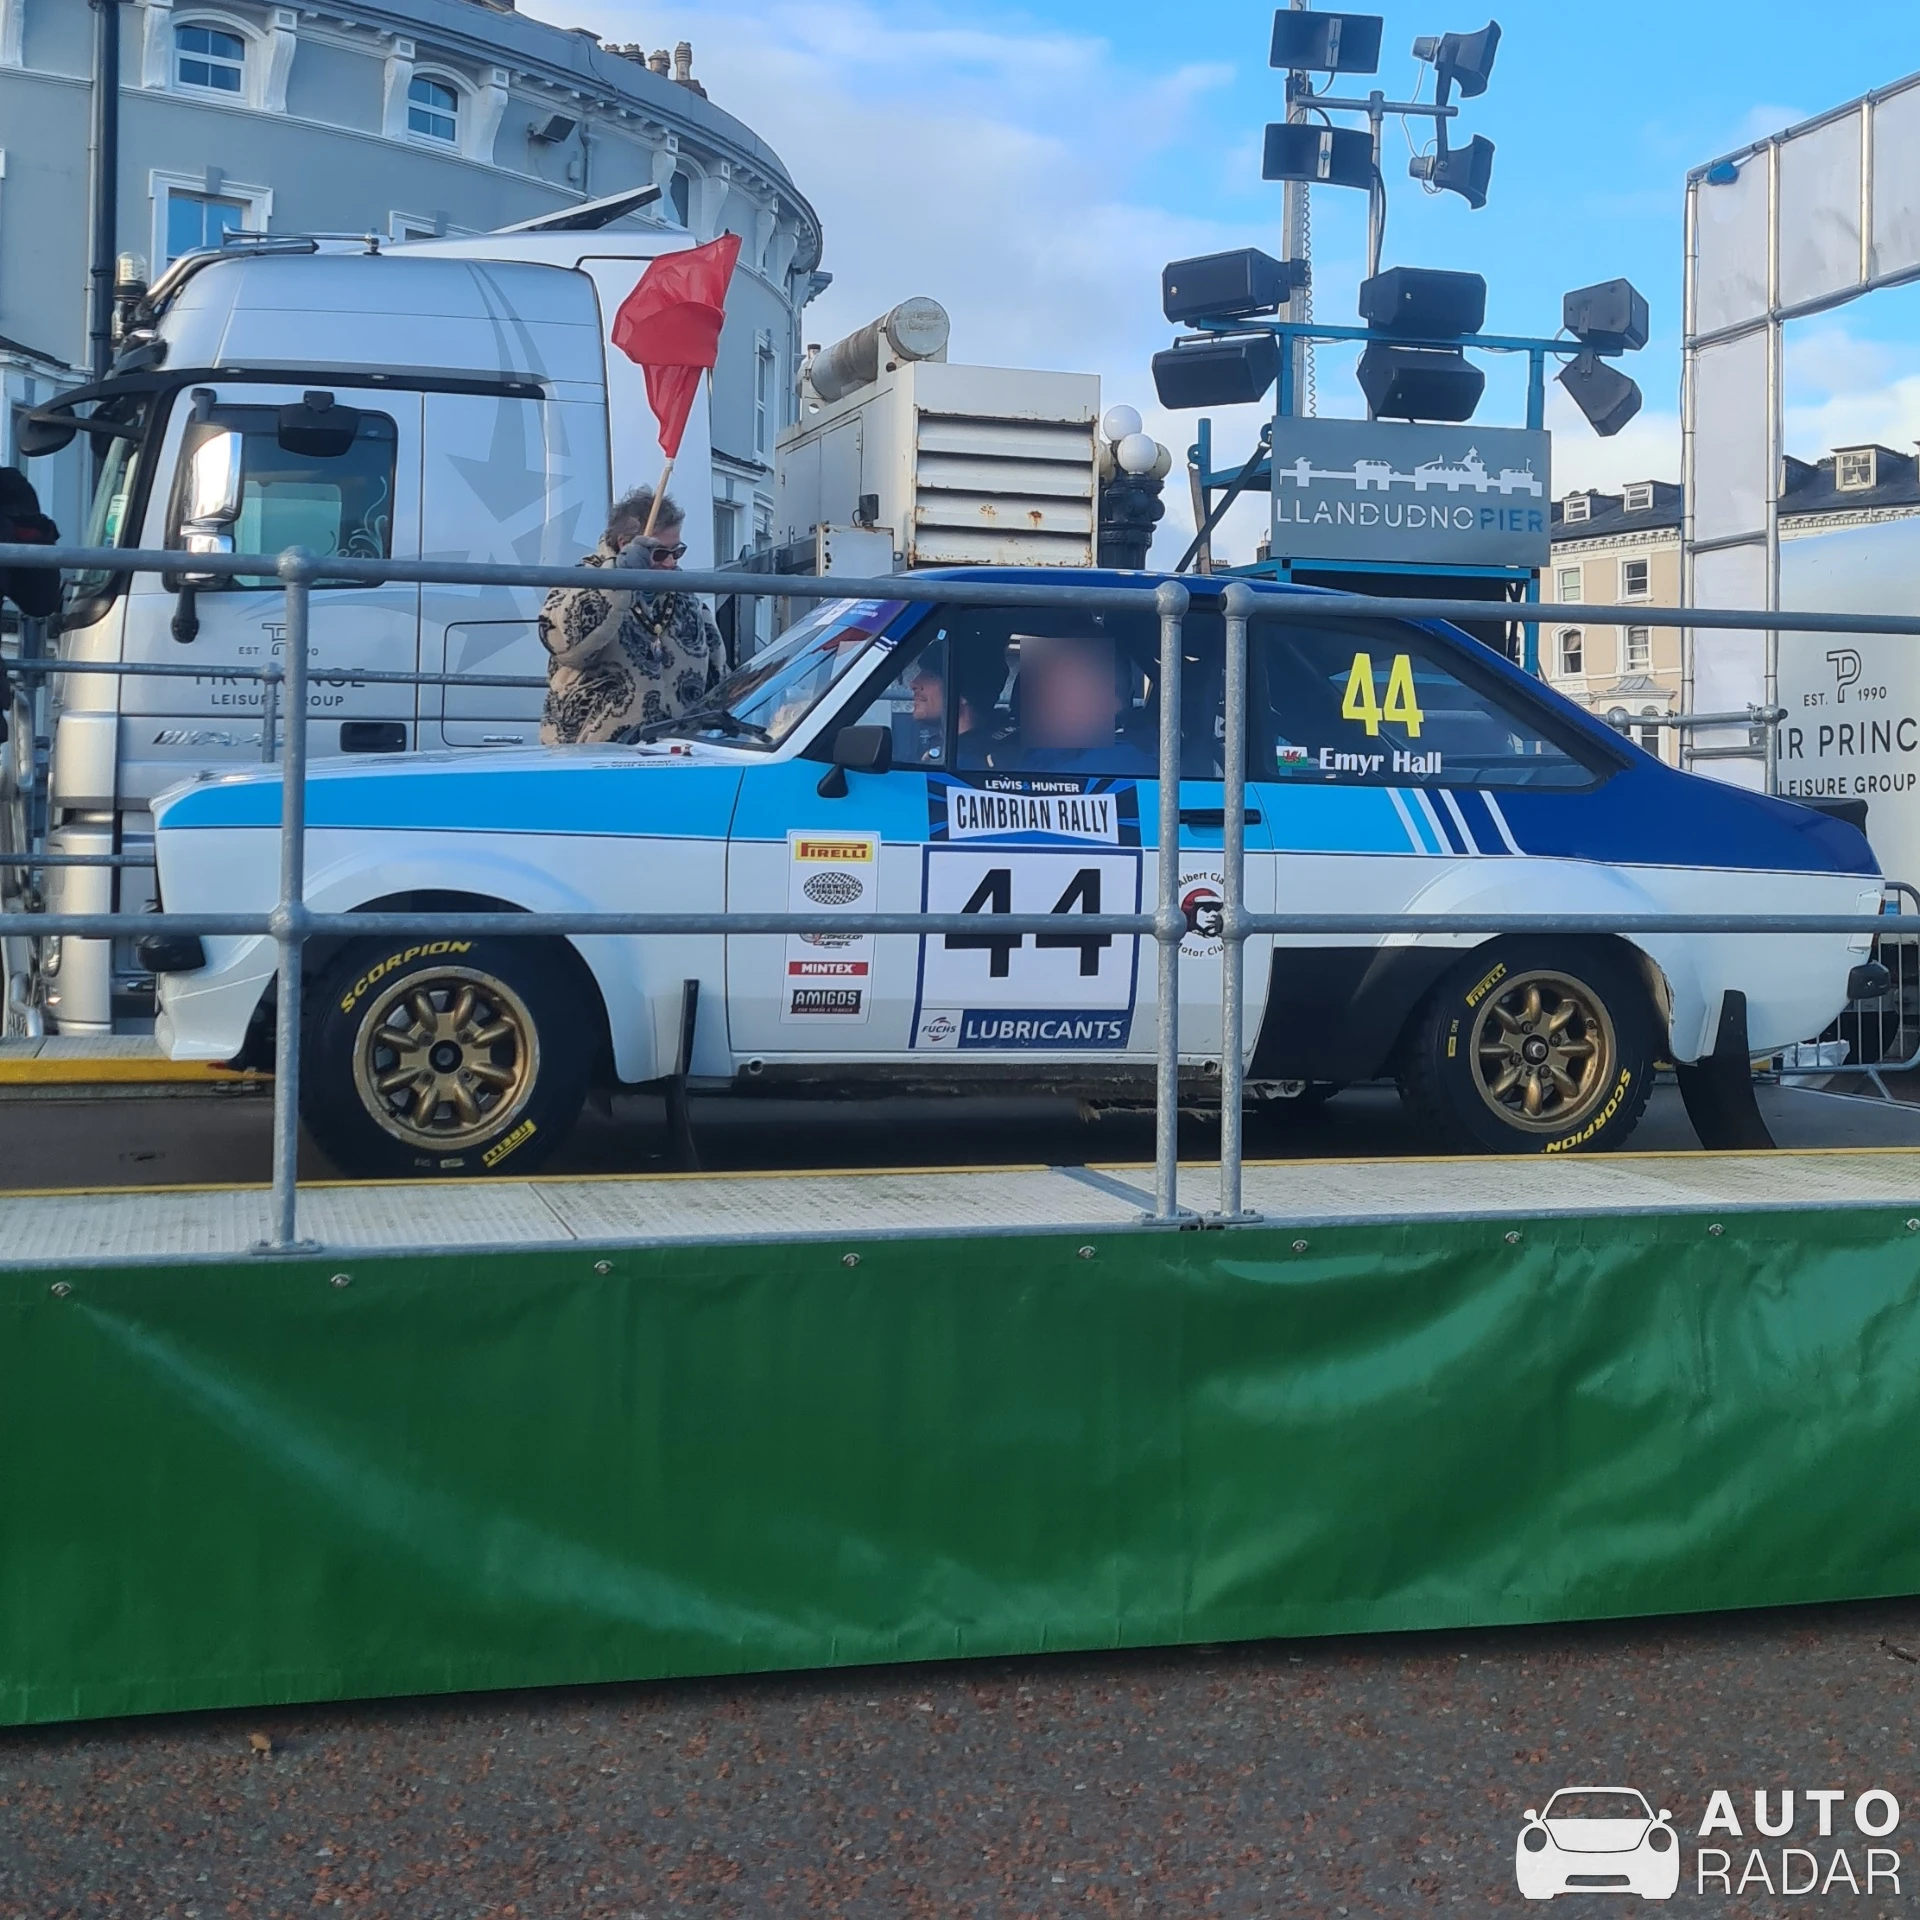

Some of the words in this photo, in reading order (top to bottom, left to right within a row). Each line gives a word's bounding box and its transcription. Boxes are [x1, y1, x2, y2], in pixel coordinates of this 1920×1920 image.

[1342, 652, 1424, 738] 44
[1803, 692, 1828, 706] EST.
[1858, 686, 1887, 701] 1990
[1778, 728, 1804, 760] IR
[1819, 717, 1919, 758] PRINC
[1319, 747, 1385, 776] Emyr
[1392, 750, 1442, 774] Hall
[1779, 777, 1847, 796] LEISURE
[1855, 773, 1916, 794] GROUP
[956, 794, 1051, 830] CAMBRIAN
[1058, 800, 1108, 833] RALLY
[801, 842, 867, 858] PIRELLI
[1178, 872, 1207, 888] Albert
[1210, 872, 1224, 885] Cla
[945, 869, 1112, 977] 44
[1207, 944, 1224, 956] Clu
[341, 941, 472, 1013] SCORPION
[801, 963, 853, 973] MINTEX
[795, 991, 857, 1005] AMIGOS
[1465, 963, 1507, 1007] PIRELLI
[921, 1025, 956, 1034] FUCHS
[966, 1020, 1122, 1040] LUBRICANTS
[1546, 1068, 1631, 1153] SCORPION
